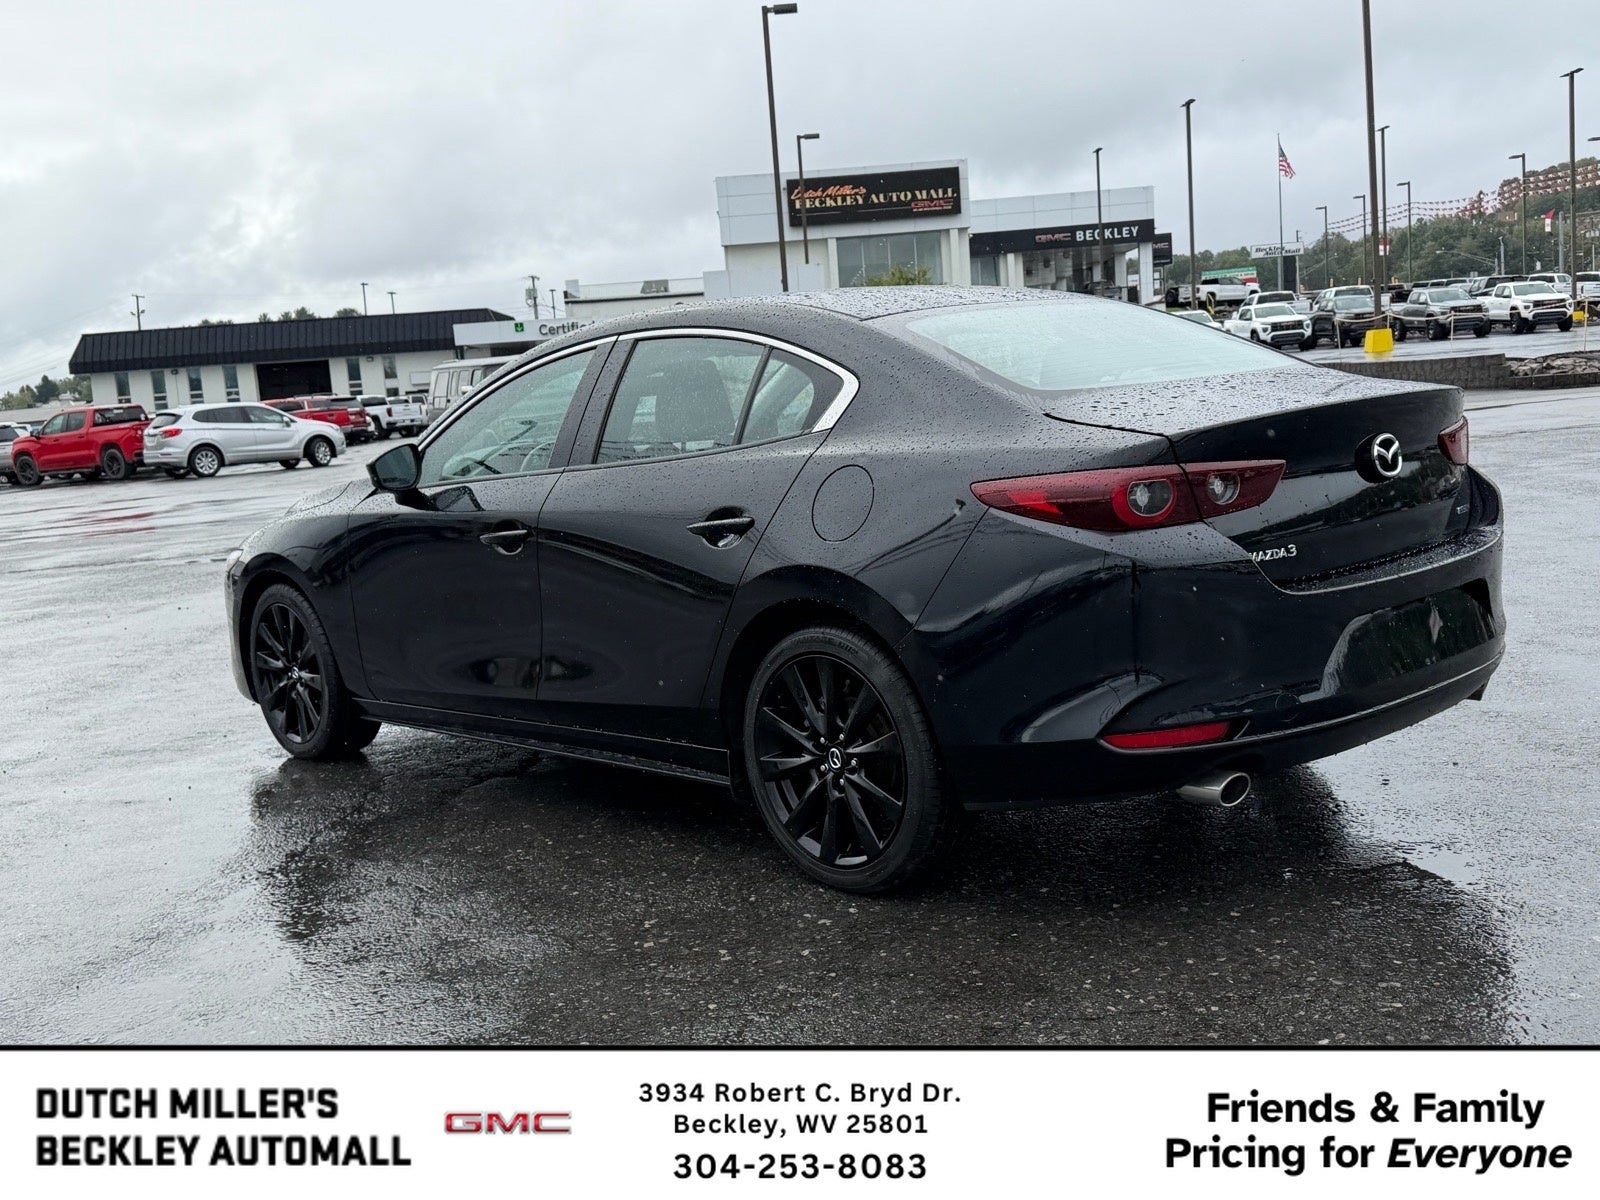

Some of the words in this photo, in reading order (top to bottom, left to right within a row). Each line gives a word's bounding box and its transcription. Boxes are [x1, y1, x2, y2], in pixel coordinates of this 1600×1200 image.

[868, 190, 912, 204] AUTO
[914, 187, 957, 200] MALL
[911, 198, 954, 209] GMC
[1035, 232, 1072, 243] GMC
[1075, 226, 1139, 241] BECKLEY
[538, 320, 595, 336] Certifi
